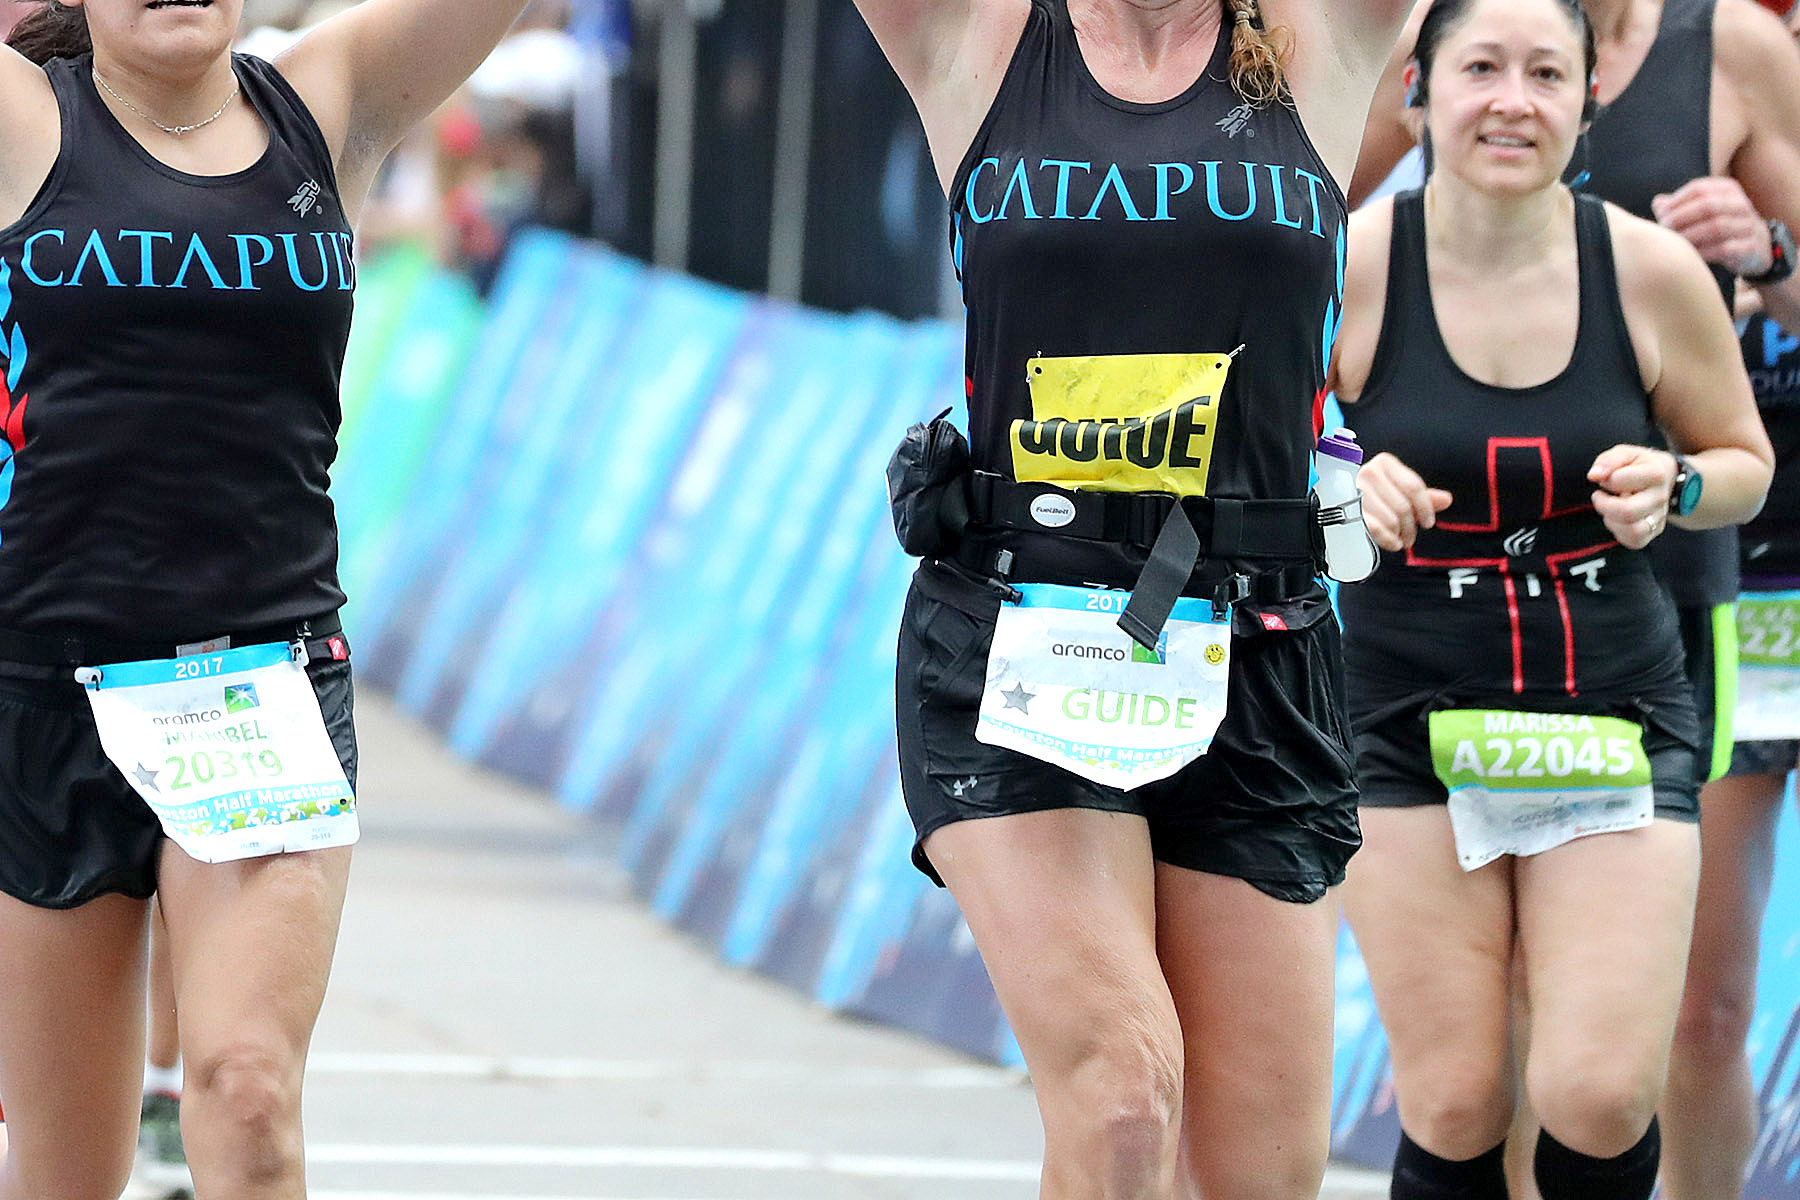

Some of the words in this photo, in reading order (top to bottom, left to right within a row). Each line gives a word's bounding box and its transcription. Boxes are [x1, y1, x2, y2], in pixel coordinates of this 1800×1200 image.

[964, 156, 1327, 239] CATAPULT
[1086, 593, 1132, 612] 201
[1052, 642, 1126, 661] aramco
[175, 656, 224, 679] 2017
[152, 709, 222, 726] aramco
[1061, 687, 1198, 729] GUIDE
[1483, 712, 1595, 736] MARISSA
[1072, 744, 1112, 760] Half
[1450, 736, 1635, 779] A22045
[165, 749, 284, 791] 20319
[213, 791, 252, 814] Half
[256, 783, 344, 804] Marathon
